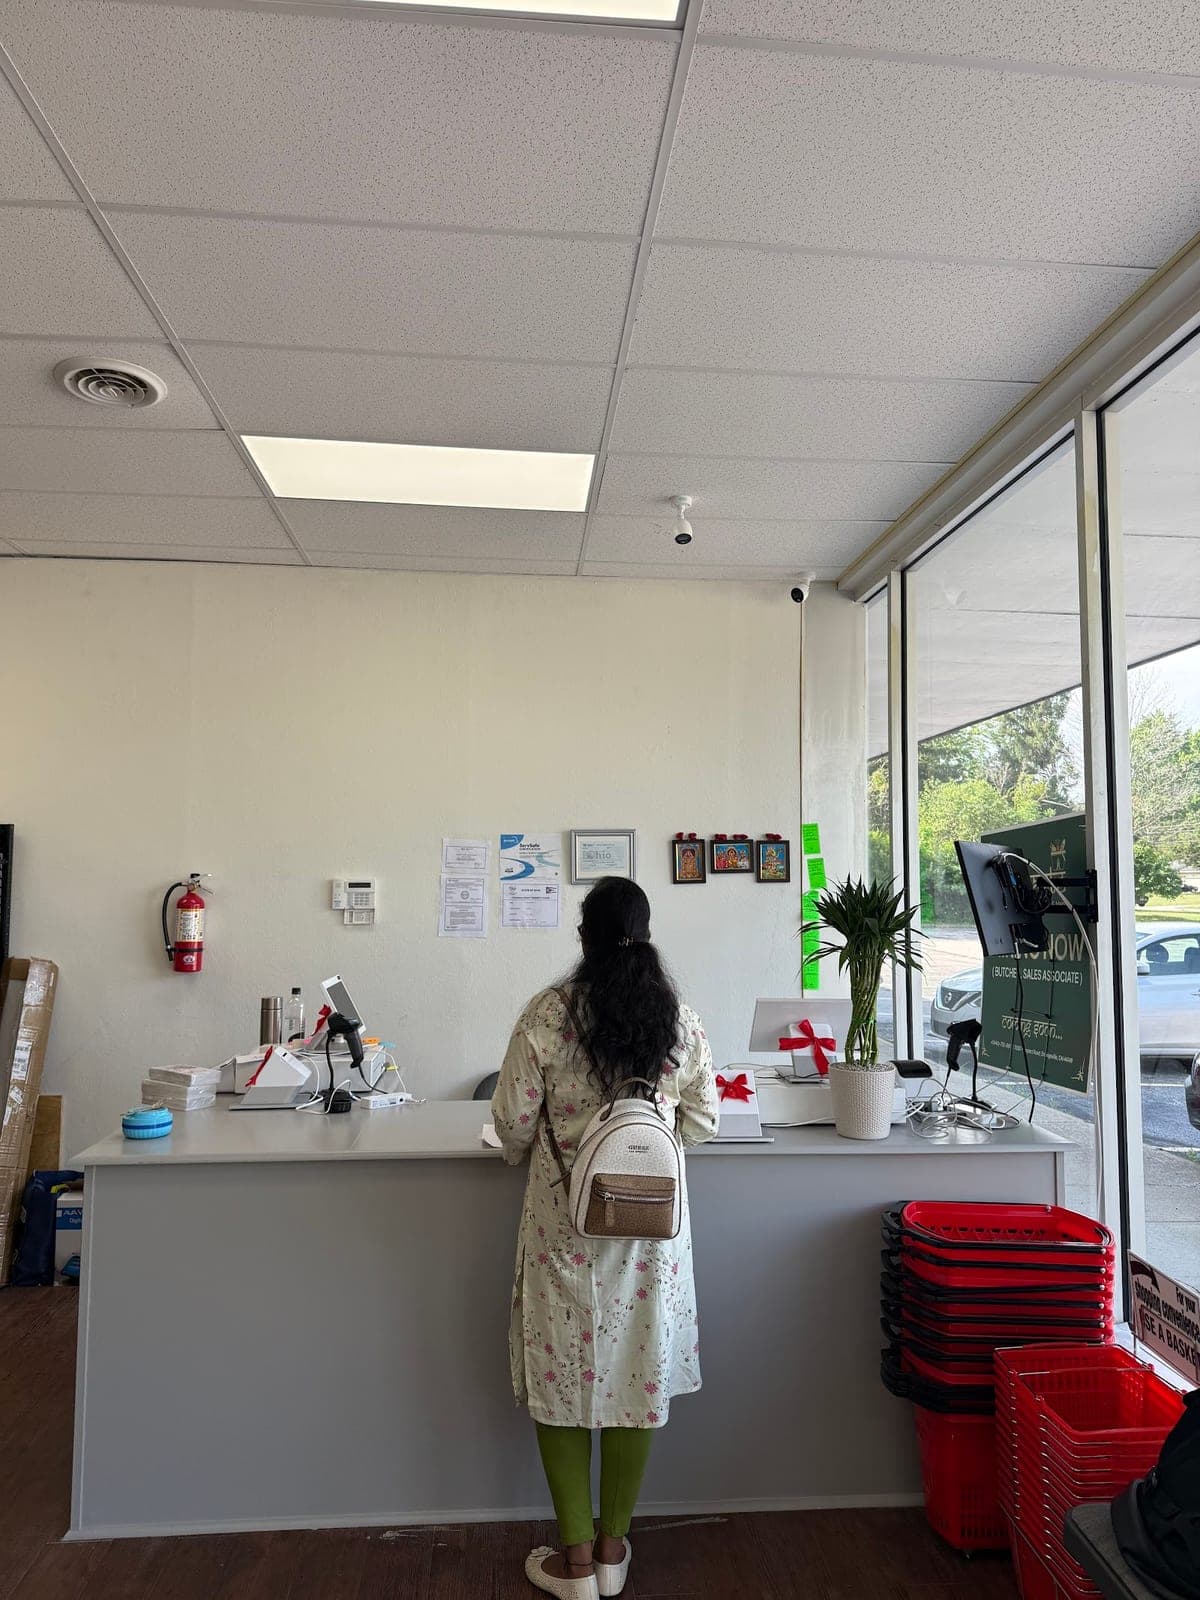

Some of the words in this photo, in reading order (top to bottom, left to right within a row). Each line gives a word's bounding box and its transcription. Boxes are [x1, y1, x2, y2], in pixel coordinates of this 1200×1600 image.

[1044, 933, 1084, 961] NOW
[992, 965, 1022, 979] (BUTCHE,
[1022, 968, 1041, 980] SALES
[1135, 1278, 1161, 1316] shopping
[1175, 1286, 1185, 1306] For
[1184, 1296, 1196, 1314] your
[1158, 1322, 1166, 1344] A
